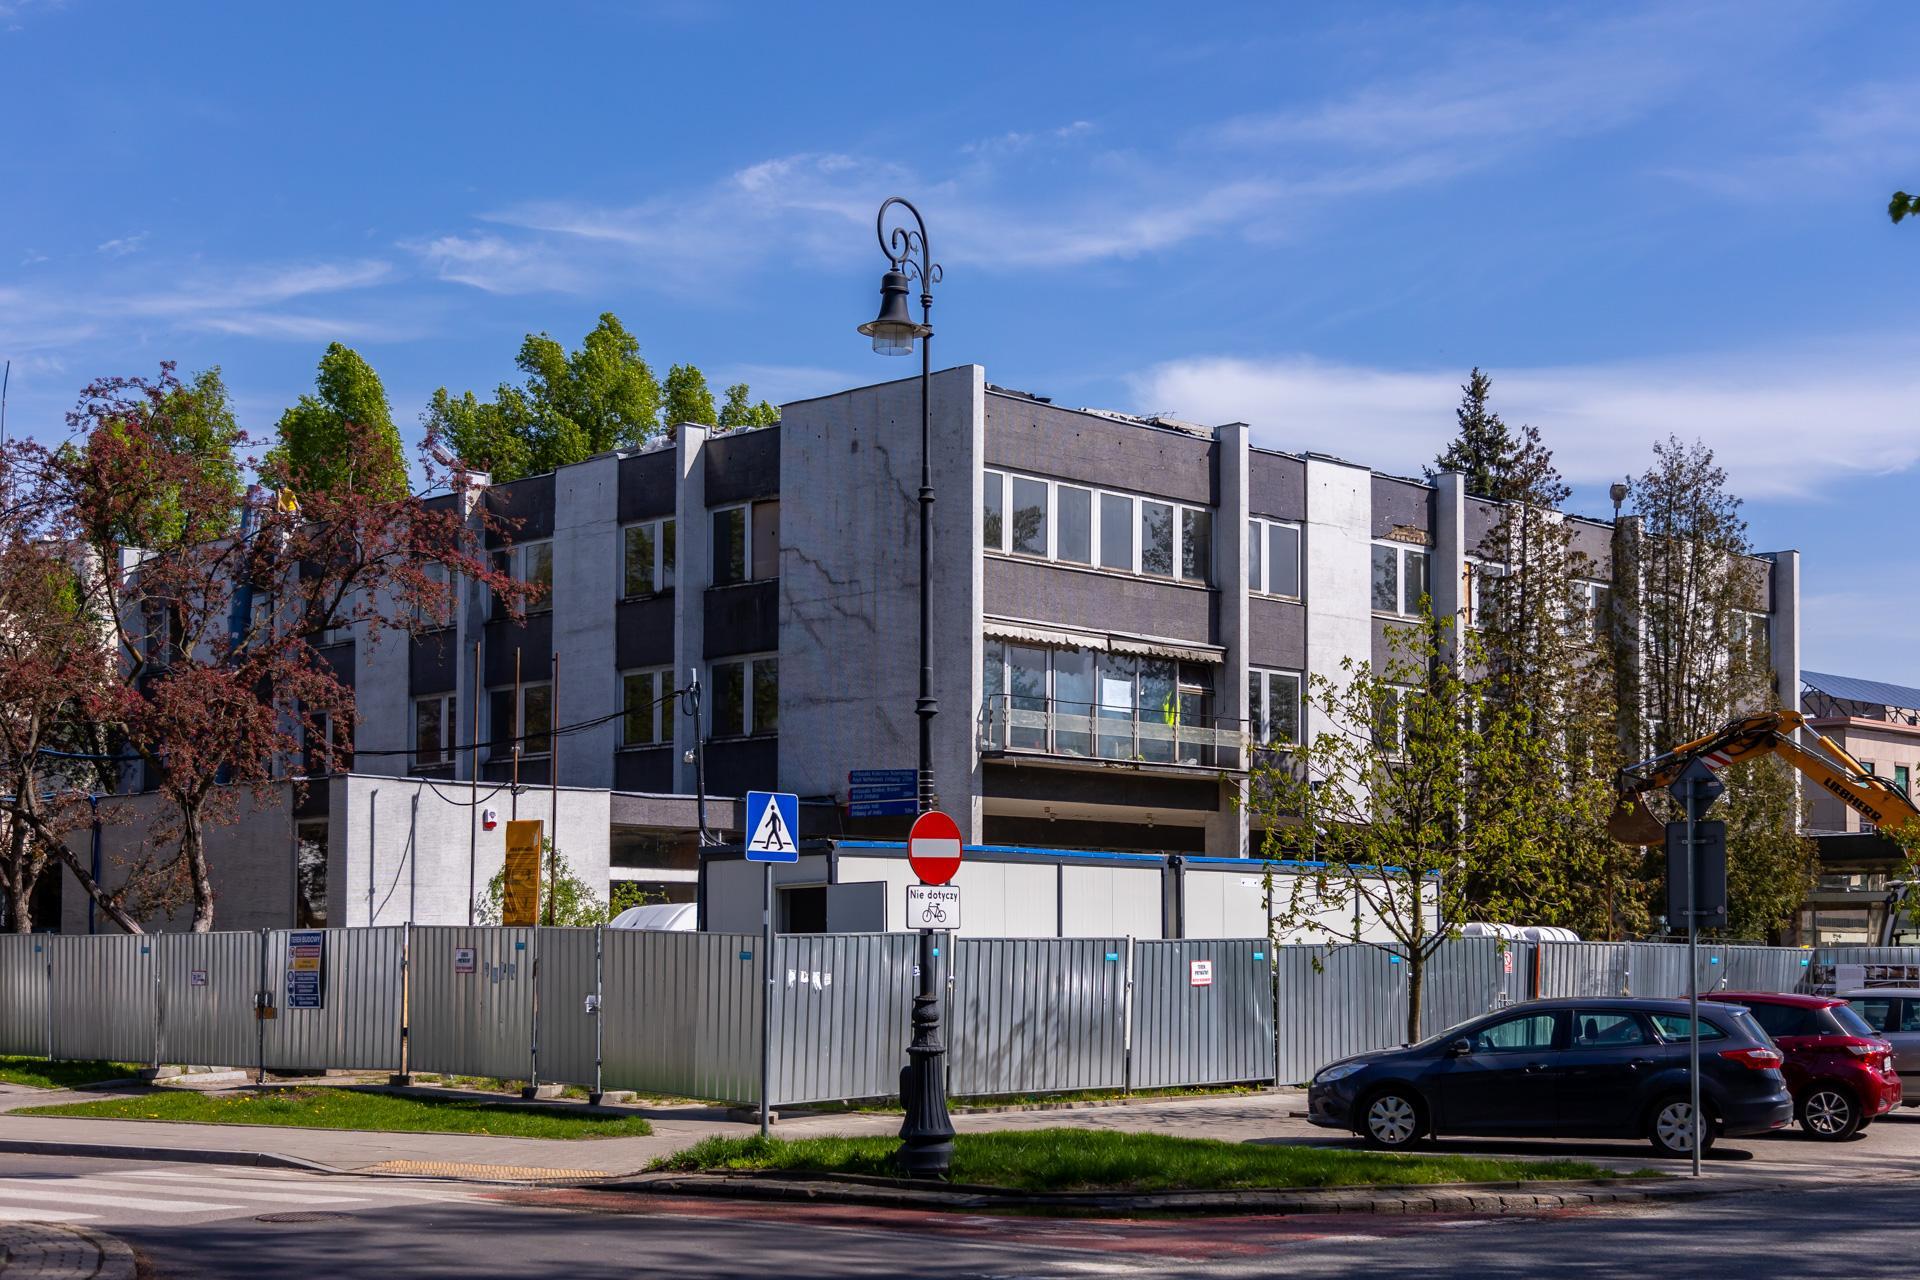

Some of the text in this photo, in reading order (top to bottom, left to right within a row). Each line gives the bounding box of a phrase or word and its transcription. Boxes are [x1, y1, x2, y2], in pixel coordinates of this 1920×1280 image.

[1824, 777, 1882, 822] LIEBHERR
[910, 889, 958, 902] Nie dotyczy
